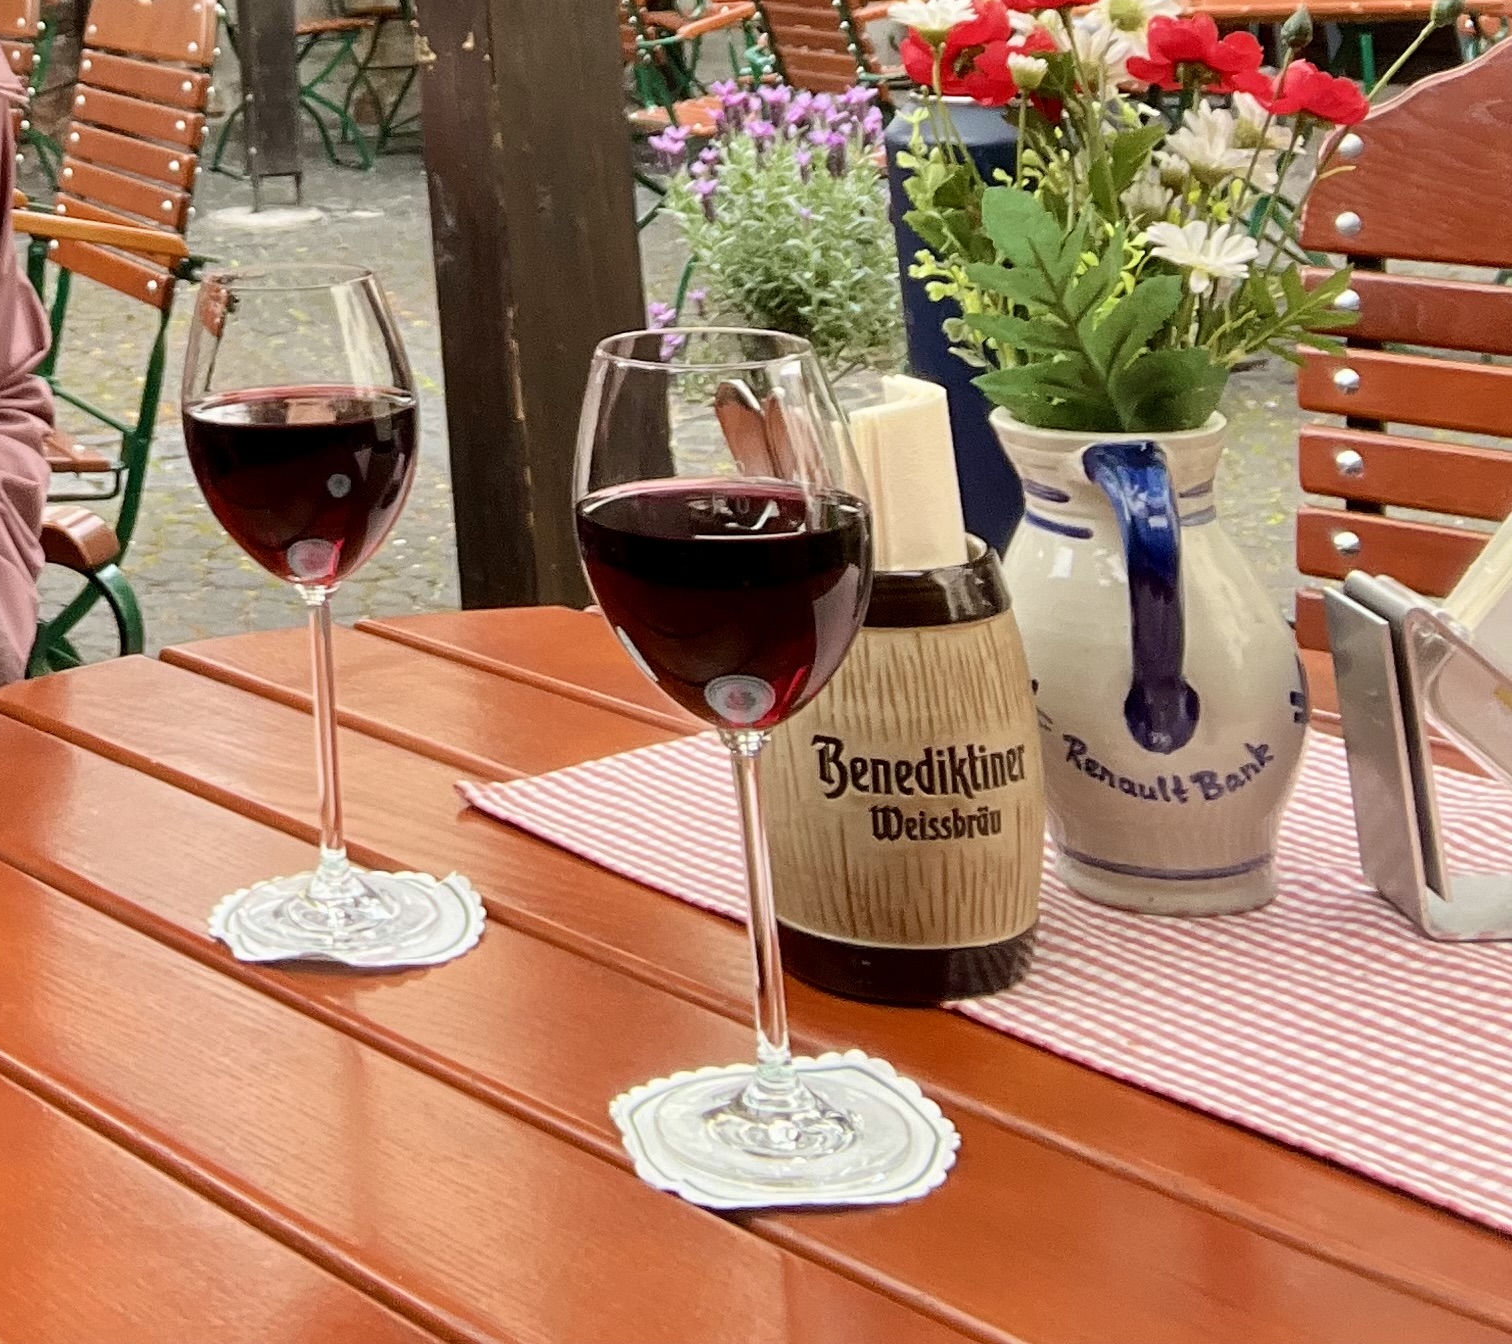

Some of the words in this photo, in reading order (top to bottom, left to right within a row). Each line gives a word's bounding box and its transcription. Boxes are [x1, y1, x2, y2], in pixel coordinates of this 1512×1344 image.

[811, 734, 1025, 799] Benediktiner
[1063, 733, 1189, 804] Renault
[1190, 742, 1275, 801] Bank
[868, 805, 1002, 841] Weissbräu
